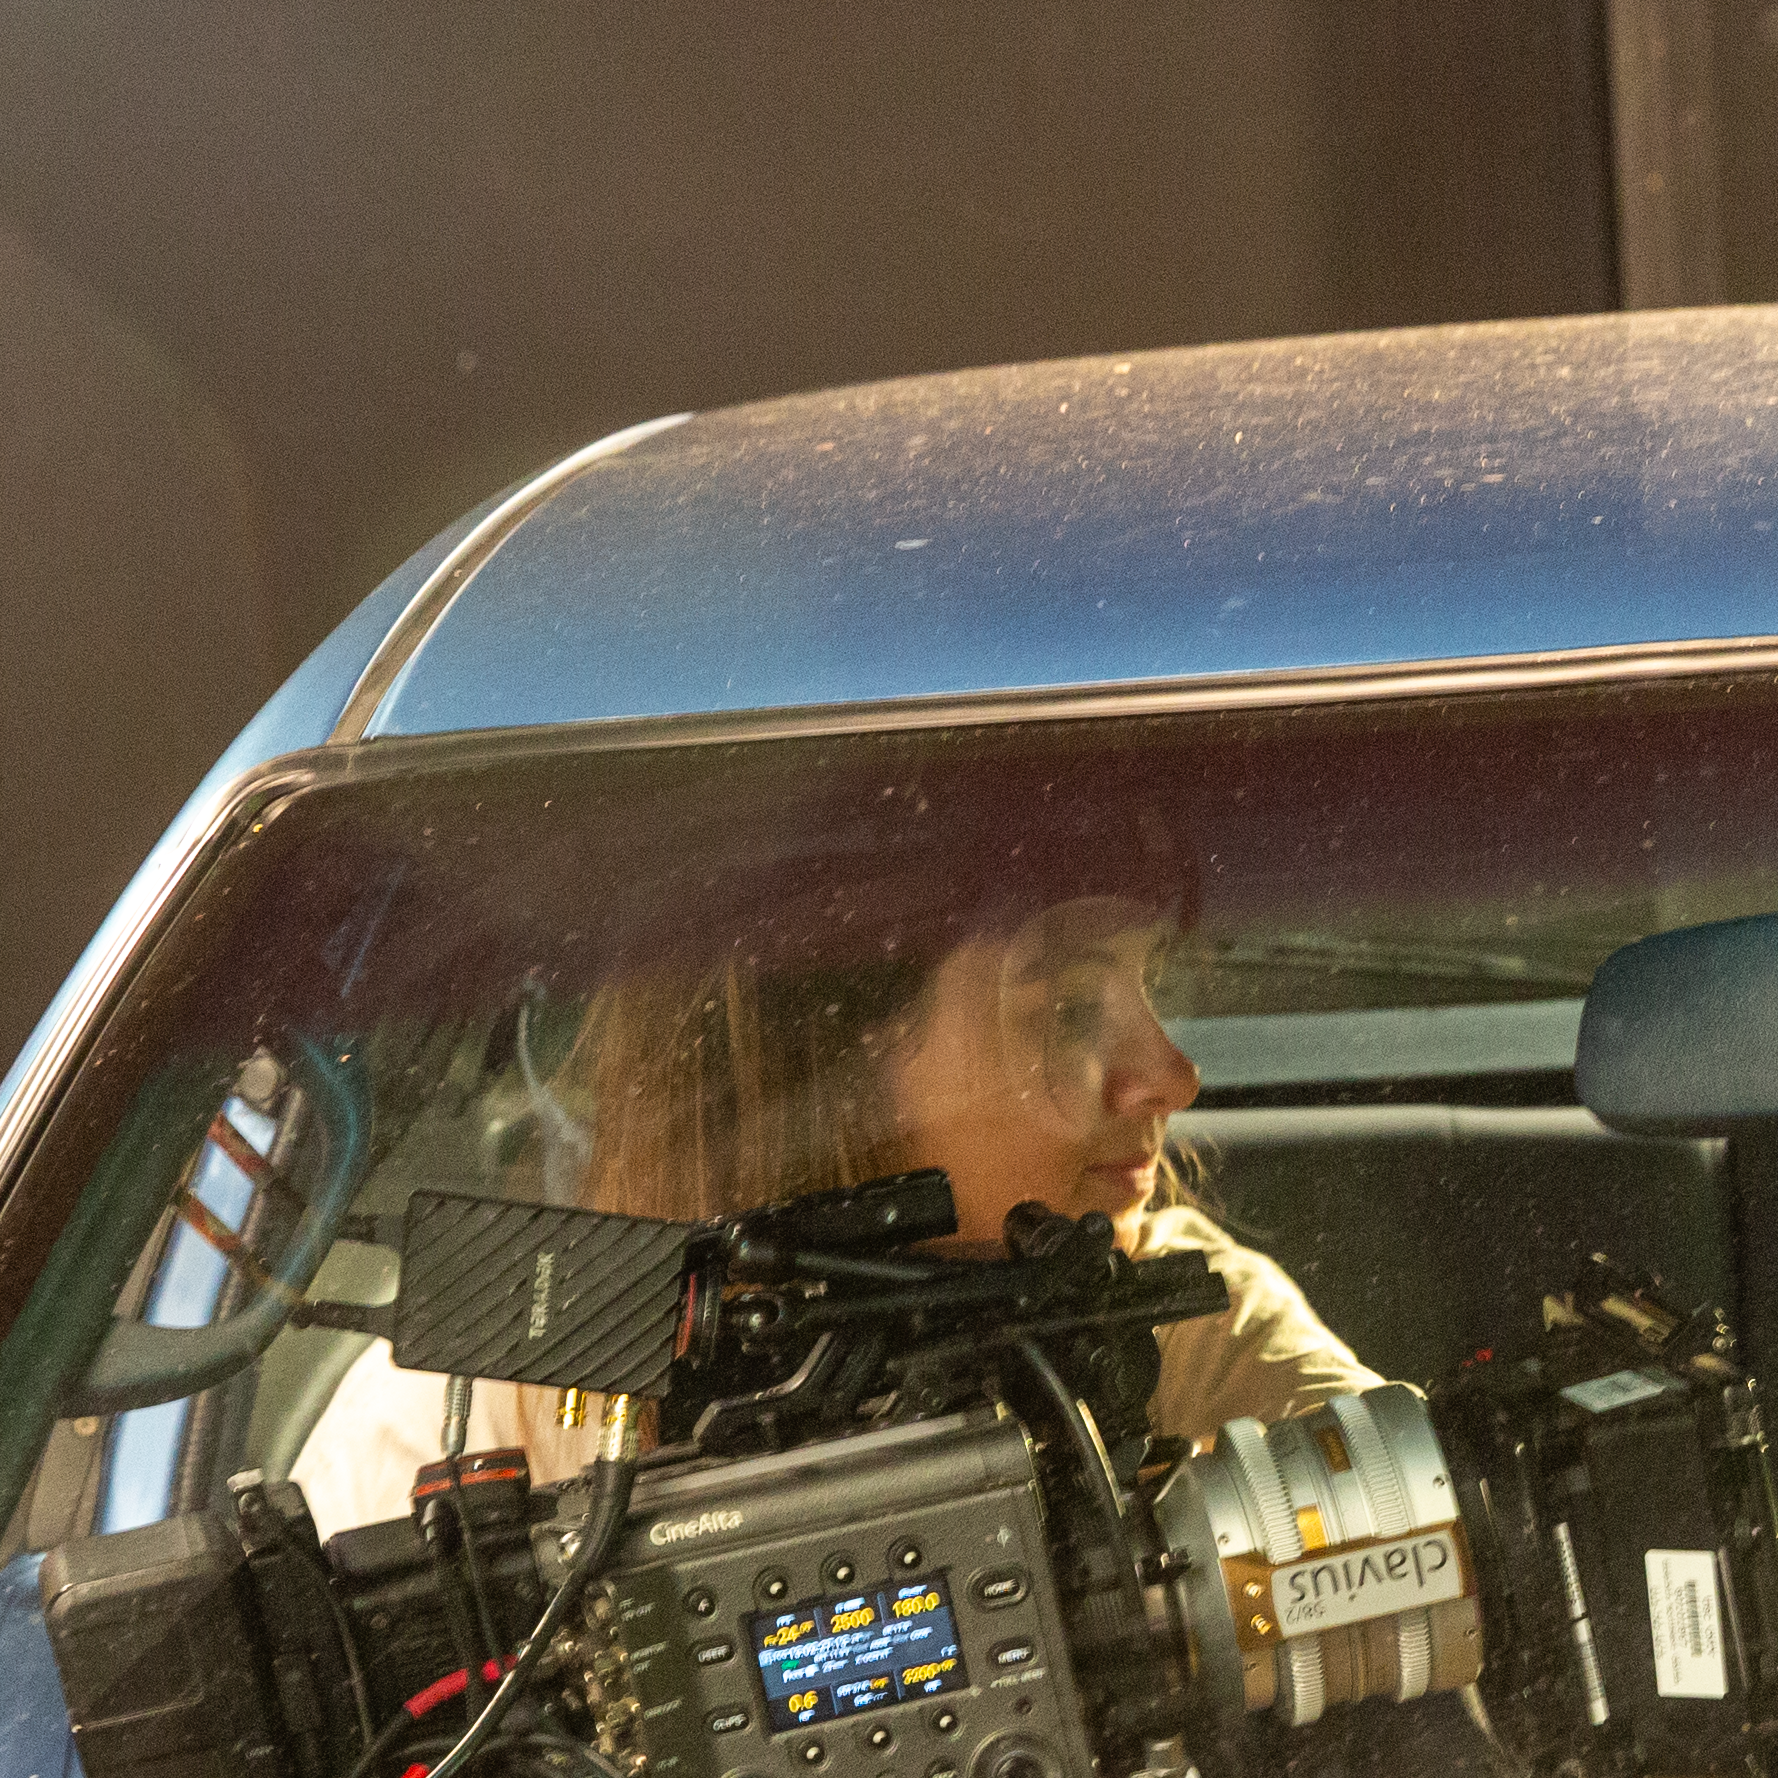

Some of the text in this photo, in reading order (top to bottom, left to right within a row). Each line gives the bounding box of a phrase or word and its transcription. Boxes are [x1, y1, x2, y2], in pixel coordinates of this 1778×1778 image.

[528, 1251, 555, 1340] TERADEK
[649, 1510, 744, 1546] CineAlta
[1289, 1538, 1448, 1604] clavius
